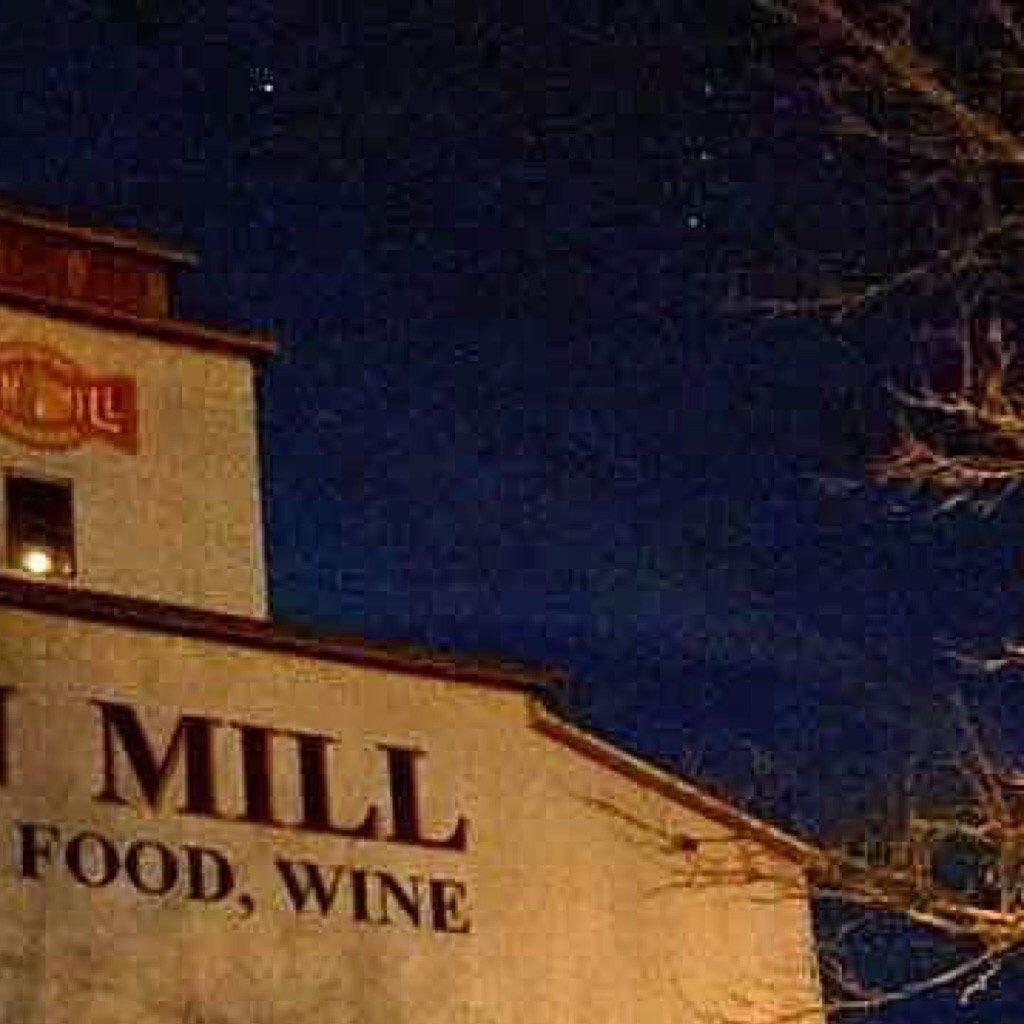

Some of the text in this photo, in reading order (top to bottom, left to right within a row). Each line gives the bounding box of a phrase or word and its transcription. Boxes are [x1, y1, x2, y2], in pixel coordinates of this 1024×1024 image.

[91, 700, 469, 851] MILL
[18, 823, 255, 919] FOOD,
[276, 861, 471, 933] WINE
